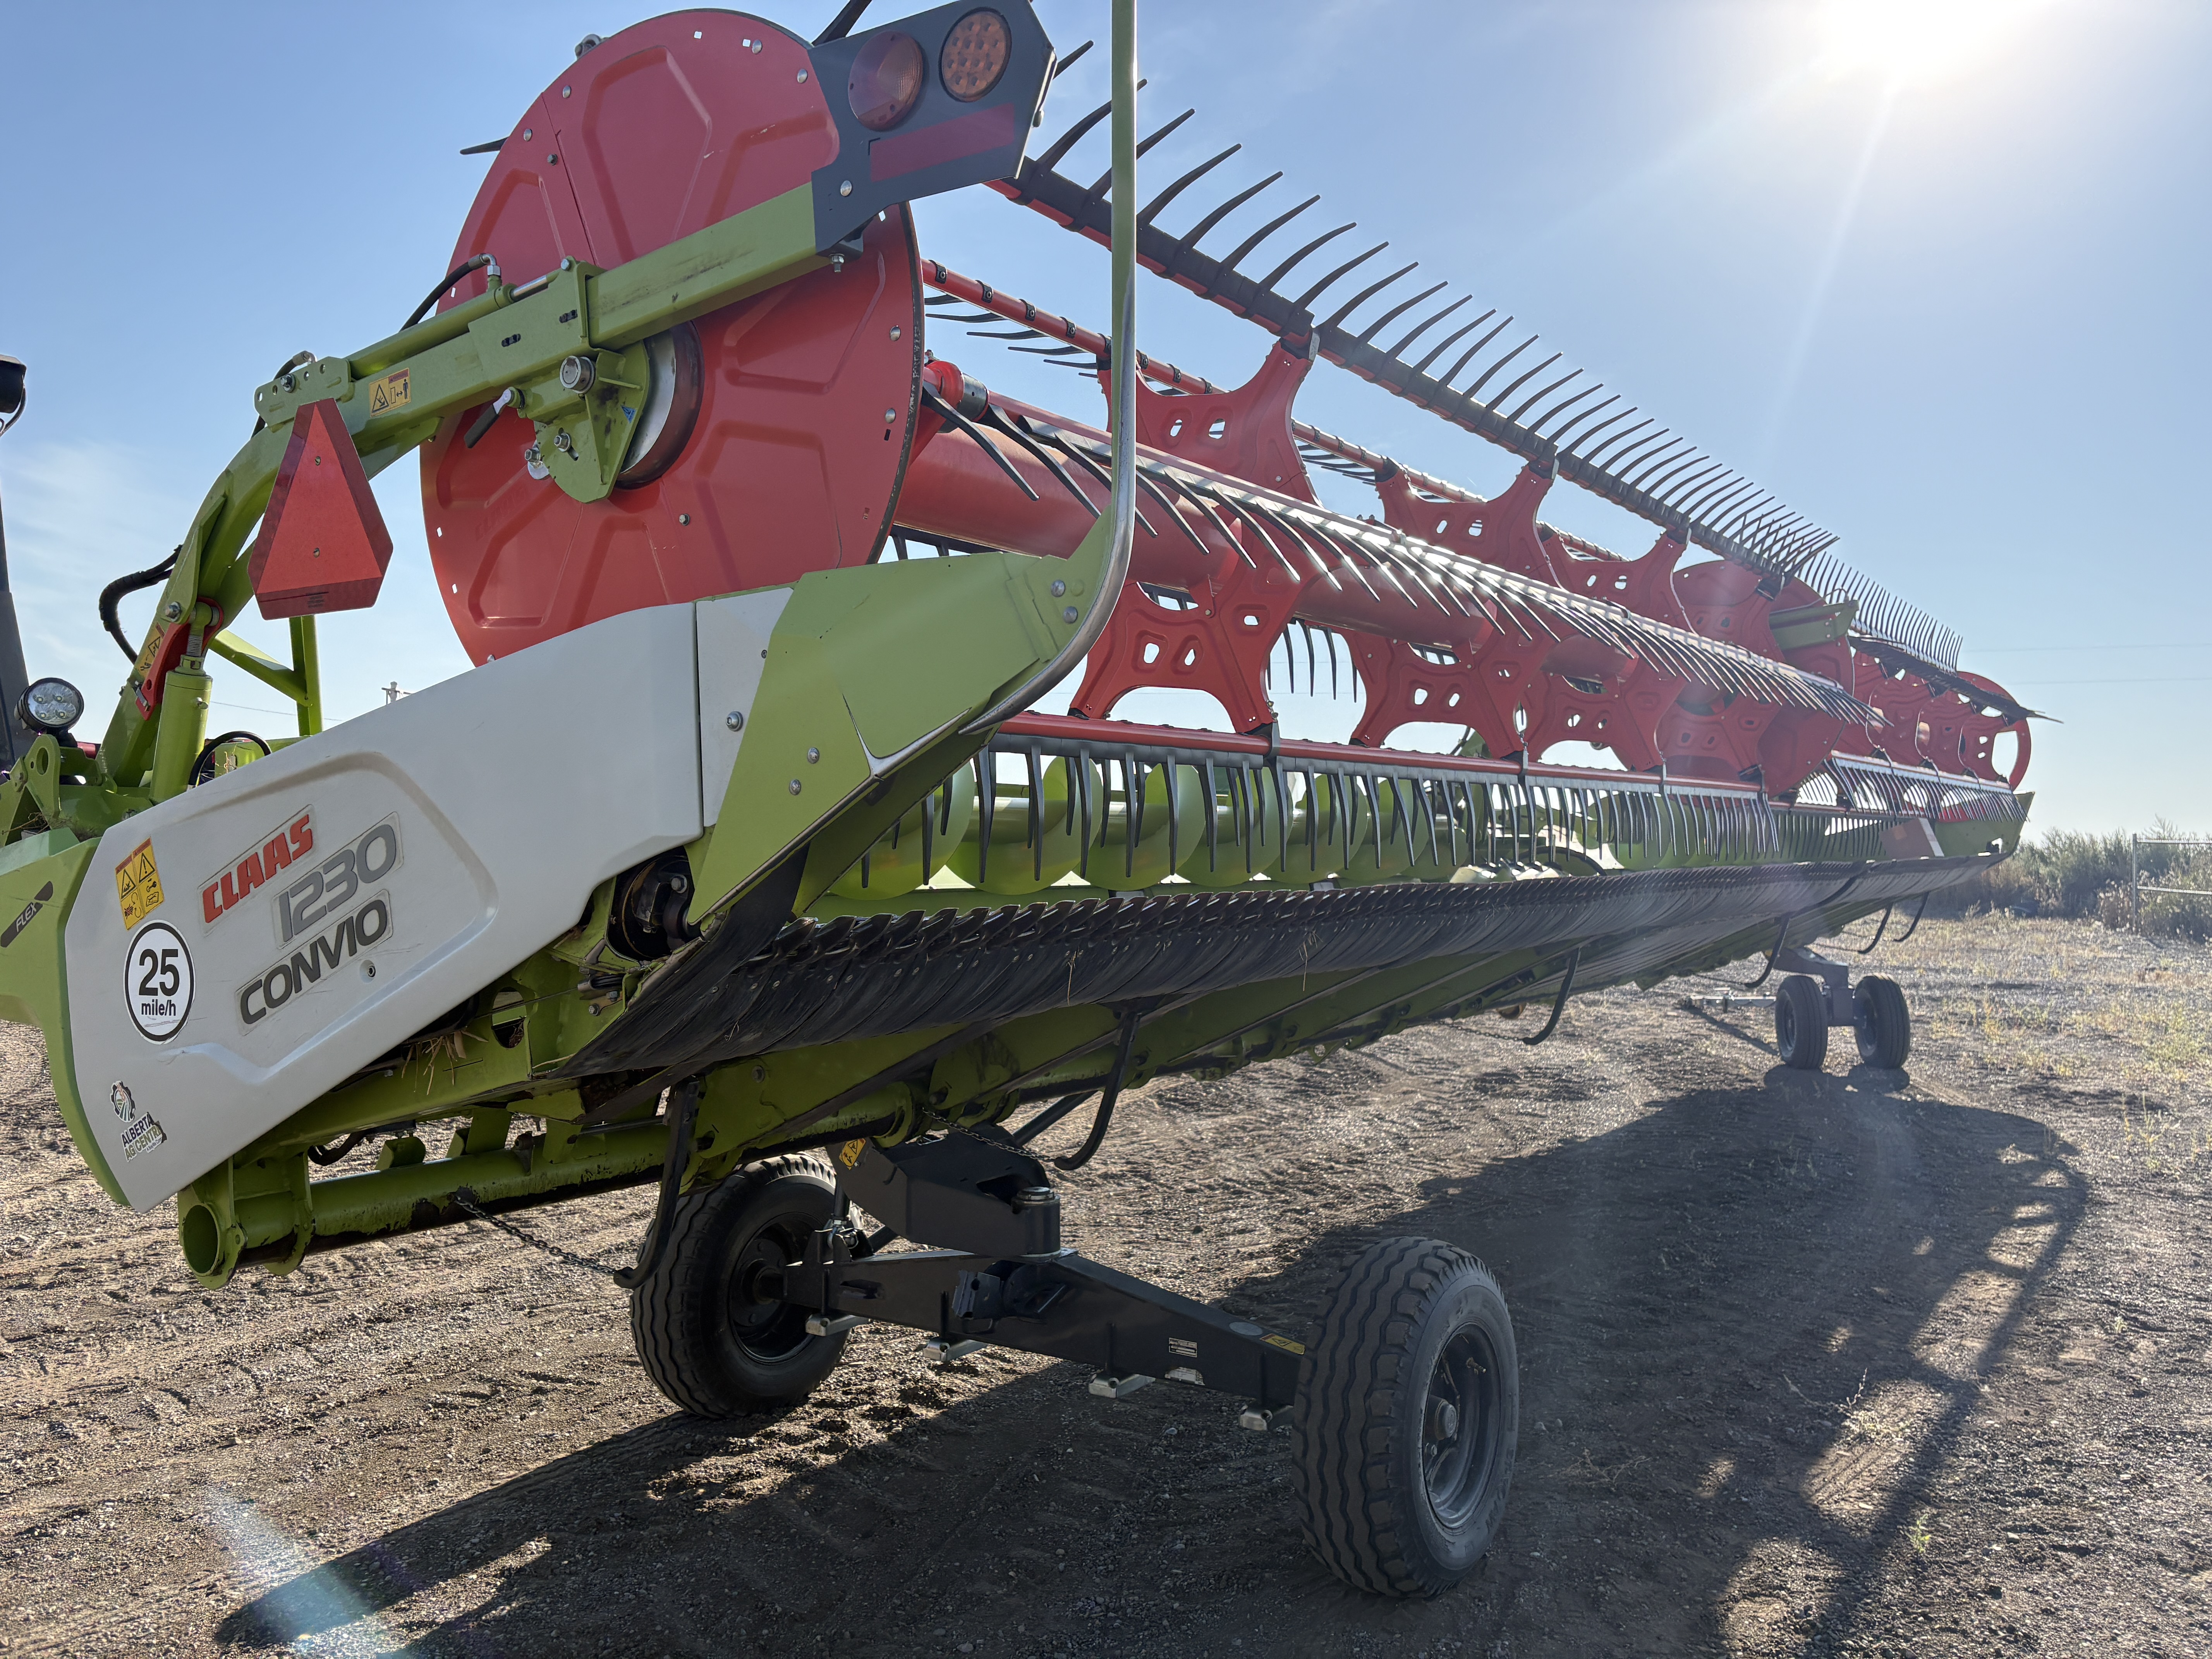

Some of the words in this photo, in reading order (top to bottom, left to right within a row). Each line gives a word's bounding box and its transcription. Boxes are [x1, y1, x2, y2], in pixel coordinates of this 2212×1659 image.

[202, 814, 313, 923] CLAAS
[278, 824, 396, 942] 1230
[16, 903, 36, 932] FLEX
[139, 949, 180, 996] 25
[240, 899, 387, 1024] CONVIO
[141, 999, 176, 1016] mile/h
[122, 1114, 155, 1147] ALBERTA
[125, 1144, 136, 1161] AG
[134, 1126, 161, 1151] CENTR
